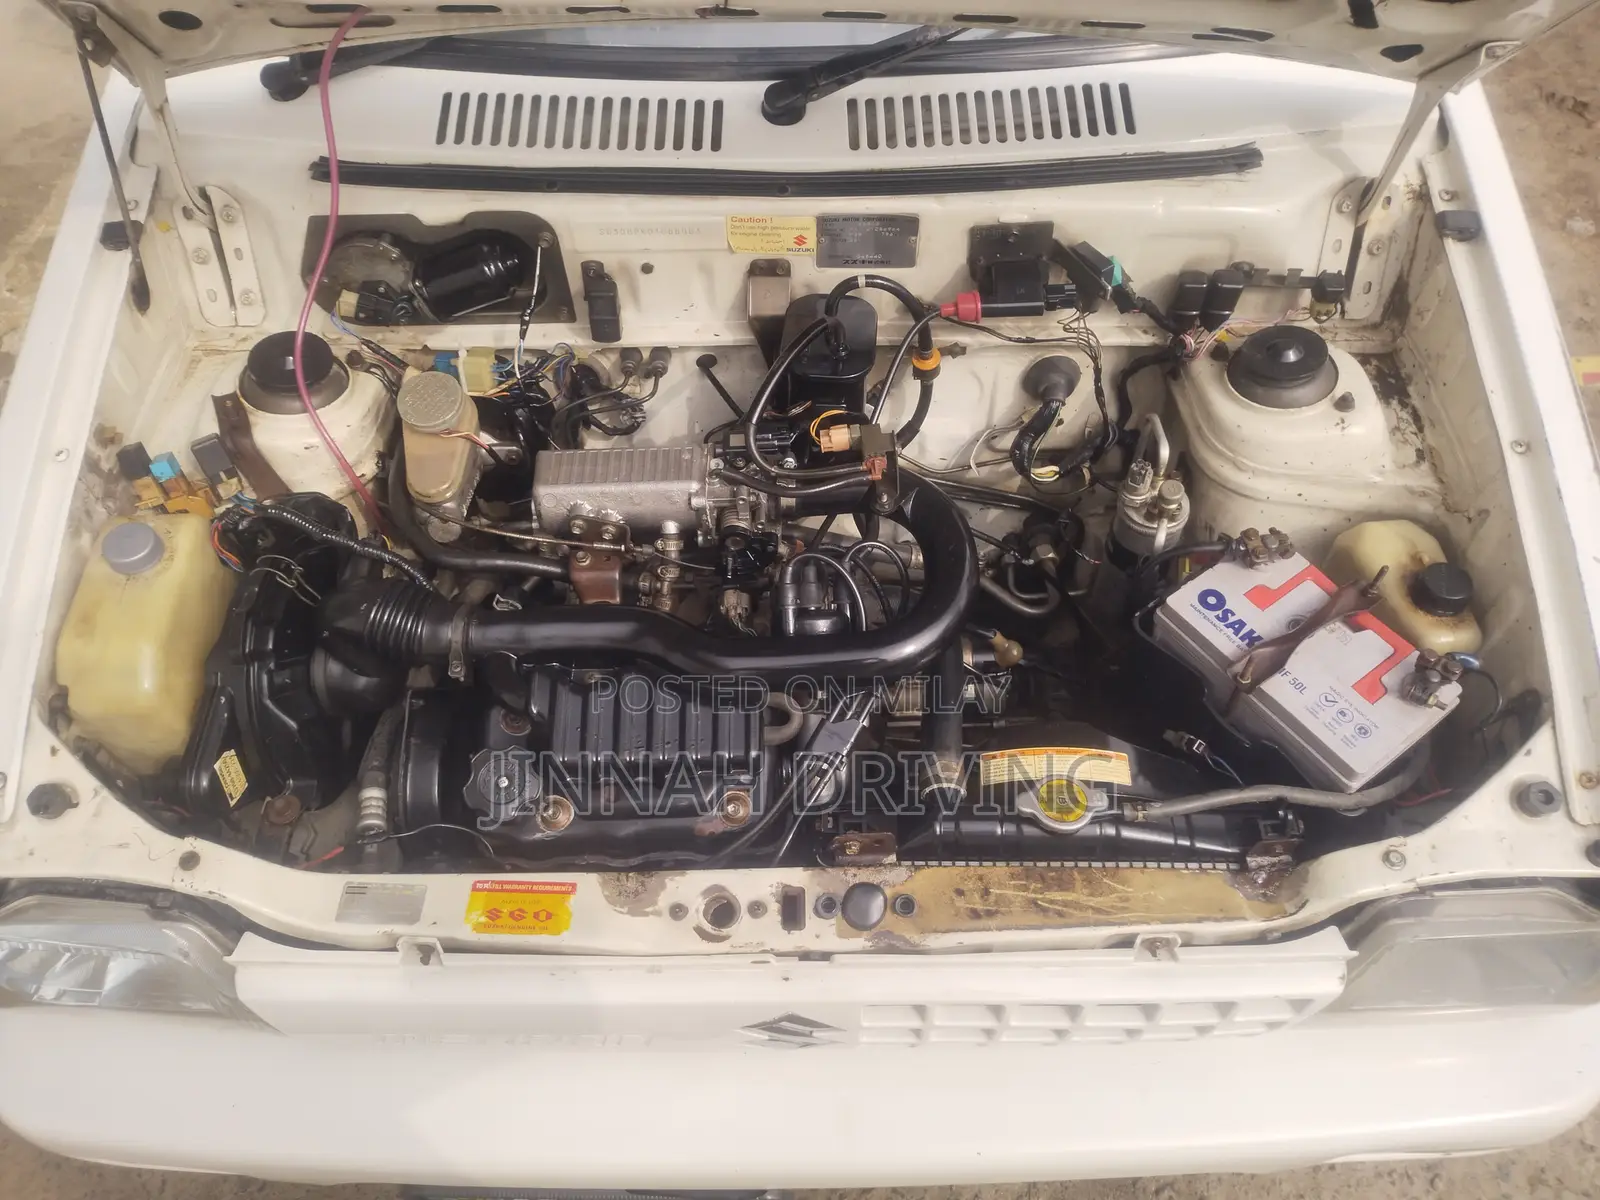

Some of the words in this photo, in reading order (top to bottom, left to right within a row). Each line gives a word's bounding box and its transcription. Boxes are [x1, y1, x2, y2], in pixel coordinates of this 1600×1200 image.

[731, 216, 767, 224] Caution
[1189, 602, 1225, 634] MAINTENANCE
[1197, 588, 1265, 649] OSAK
[1288, 677, 1309, 696] 50L
[502, 883, 533, 891] WARRANTY
[532, 884, 572, 892] REQUIREMENTS
